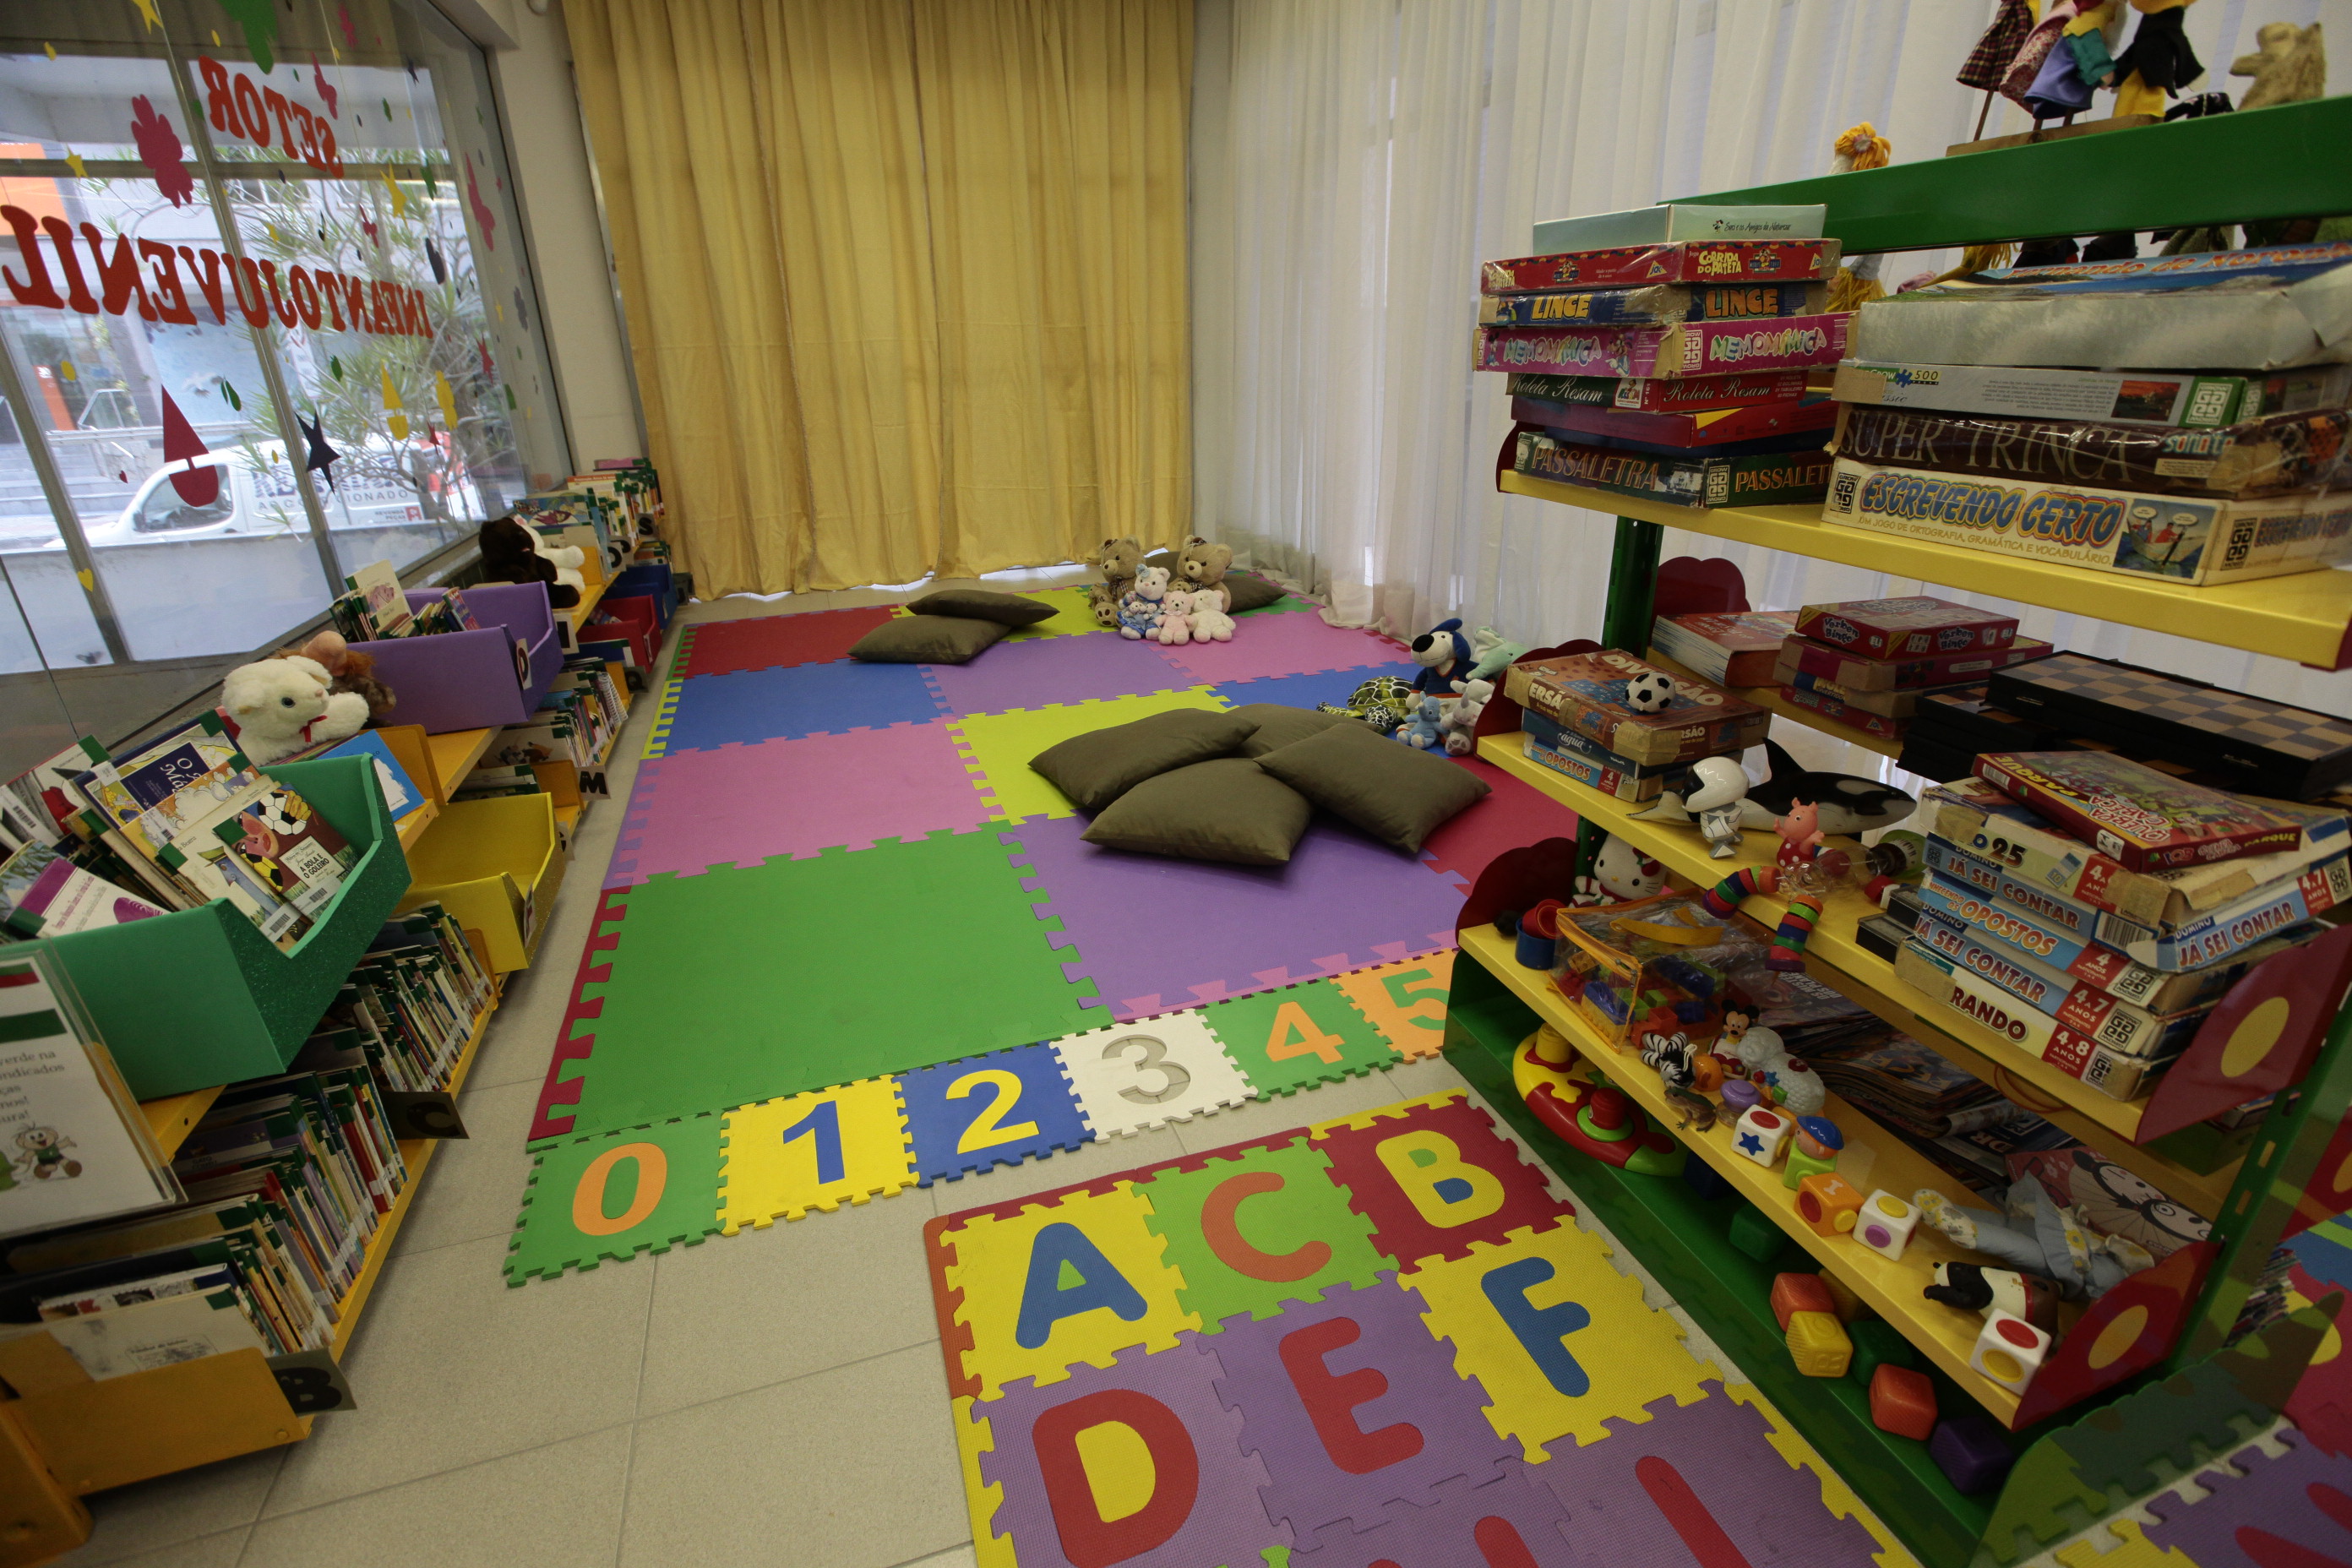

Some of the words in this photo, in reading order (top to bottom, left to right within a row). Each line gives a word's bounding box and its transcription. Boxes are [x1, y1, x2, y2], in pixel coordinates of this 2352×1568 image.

[1697, 265, 1712, 275] DO
[1712, 261, 1742, 276] PATETA
[1698, 250, 1740, 265] CORRIDA
[2002, 261, 2147, 280] Fernando
[2151, 255, 2197, 273] de
[1531, 292, 1593, 321] LINCE
[1705, 287, 1779, 318] LINCE
[1552, 374, 1603, 403] Resam
[1914, 370, 1939, 381] 500
[1663, 378, 1715, 403] Roleta
[1717, 376, 1772, 399] Resam
[1840, 408, 1946, 465] SUPER
[1964, 419, 2134, 485] TRINCA
[1531, 445, 1660, 492] PASSALETRA
[1734, 463, 1832, 493] PASSALET
[1861, 472, 2026, 533] ESCREVENDO
[2018, 491, 2127, 547] CERTO
[639, 517, 653, 535] S
[1859, 515, 1873, 525] UM
[1873, 517, 1896, 530] JOGO
[1897, 523, 1908, 531] DE
[1909, 524, 1966, 543] ORTOGRAFIA,
[1968, 532, 2024, 553] GRAMÁTICA
[2026, 542, 2034, 553] E
[1826, 628, 1852, 644] Bingo
[626, 670, 643, 691] Q
[1545, 750, 1591, 781] OPOSTOS
[1607, 771, 1614, 782] 4
[1994, 754, 2079, 798] PARQUE
[580, 770, 607, 794] M
[2088, 808, 2171, 841] QUEBRA
[1988, 836, 2028, 868] 25
[2244, 833, 2297, 847] PARQUE
[303, 856, 320, 869] BOLA
[308, 858, 329, 875] GOLEIRO
[1954, 845, 1998, 868] DOMINO
[2088, 864, 2104, 881] 4
[2301, 874, 2311, 890] 4
[2314, 869, 2323, 885] 7
[1947, 855, 1968, 879] JÁ
[1970, 867, 1999, 892] SEI
[2002, 883, 2080, 930] CONTAR
[1922, 903, 1964, 929] DOMINO
[1946, 901, 1960, 912] OS
[1959, 900, 2059, 956] OPOSTOS
[2175, 917, 2213, 940] DOMINO
[2179, 939, 2205, 968] JÁ
[2203, 929, 2231, 960] SEI
[2230, 901, 2297, 945] CONTAR
[1932, 928, 1966, 957] SEI
[1964, 946, 2047, 1005] CONTAR
[2085, 961, 2108, 974] ANOS
[2094, 953, 2112, 966] 4
[1949, 986, 2028, 1041] RANDO
[2067, 1004, 2097, 1023] ANOS
[2074, 988, 2089, 1004] 4
[2093, 998, 2110, 1013] 7
[2052, 1045, 2082, 1065] ANOS
[2055, 1030, 2071, 1045] 4
[2075, 1040, 2091, 1057] 8
[572, 1141, 667, 1238] 0
[781, 1102, 849, 1186] 1
[944, 1068, 1039, 1157] 2
[1101, 1033, 1191, 1104] 3
[1263, 1000, 1347, 1069] 4
[1385, 966, 1448, 1032] 5
[406, 1101, 461, 1137] C
[1015, 1222, 1148, 1351] A
[1200, 1171, 1333, 1284] C
[1375, 1129, 1505, 1228] B
[272, 1366, 342, 1413] B
[1032, 1387, 1200, 1568] D
[1277, 1315, 1425, 1476] E
[1479, 1255, 1592, 1398] F
